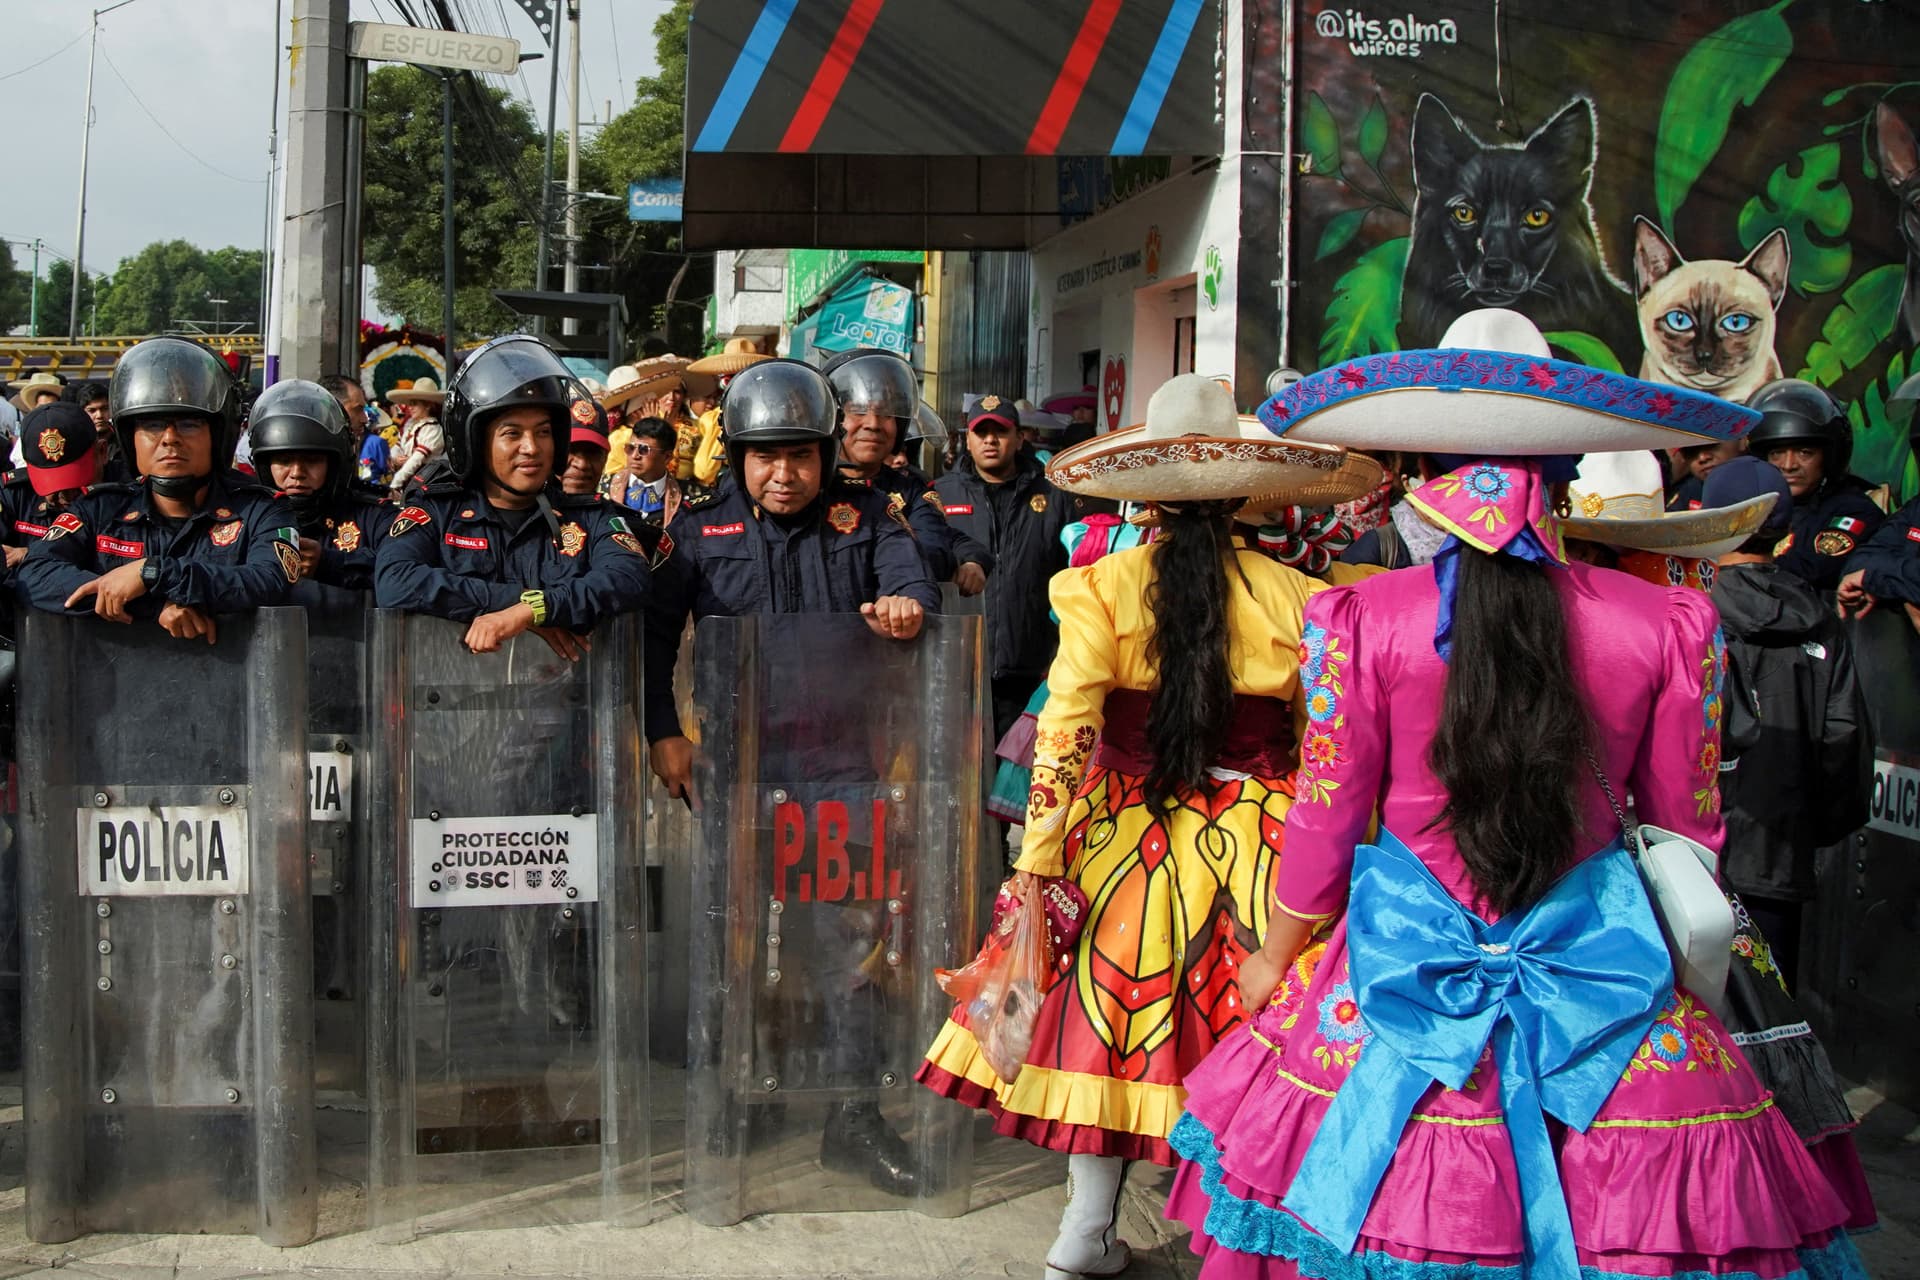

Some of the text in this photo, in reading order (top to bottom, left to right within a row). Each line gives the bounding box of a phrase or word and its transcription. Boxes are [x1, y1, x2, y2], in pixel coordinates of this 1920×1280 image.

[1316, 9, 1457, 43] @its.alma
[381, 33, 504, 65] ESFUERZO
[99, 820, 228, 882] POLICIA
[442, 827, 569, 848] PROTECCIÓN
[774, 799, 901, 903] P.B.I.
[442, 849, 569, 867] CIUDADANA
[465, 871, 509, 889] SSC
